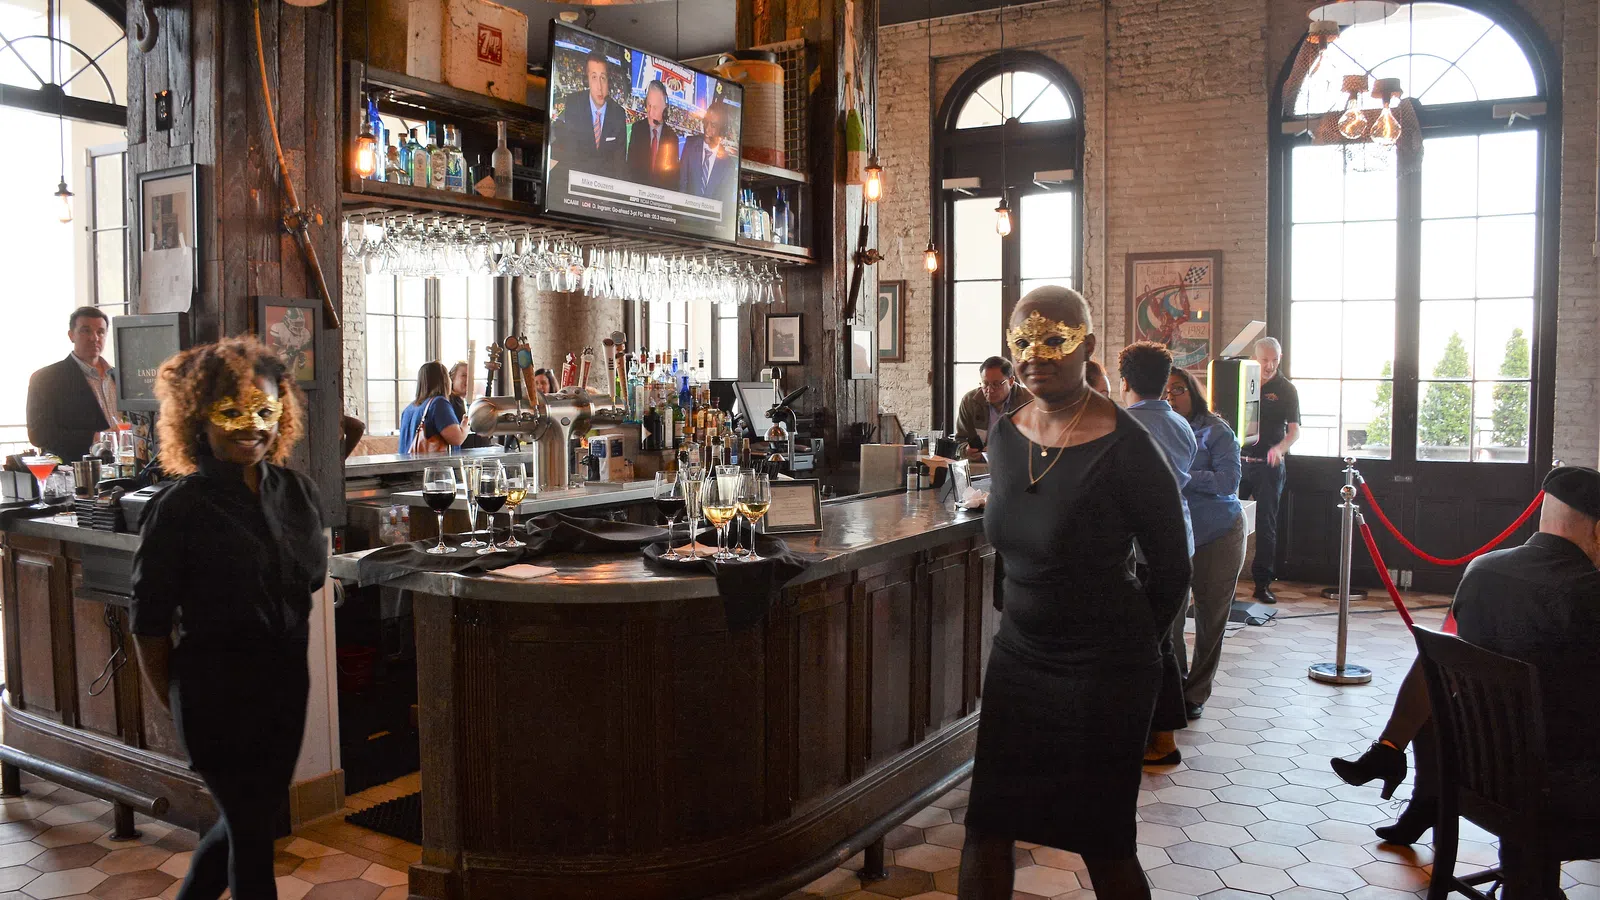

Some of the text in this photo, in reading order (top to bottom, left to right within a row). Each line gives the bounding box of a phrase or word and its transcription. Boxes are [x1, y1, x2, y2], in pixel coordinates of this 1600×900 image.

[581, 178, 614, 191] Mike Couzens
[638, 189, 665, 200] Tim Johnson
[684, 199, 701, 209] Anthony
[611, 206, 630, 215] Go-ahead
[660, 215, 677, 225] remaining
[1187, 325, 1206, 335] 1982
